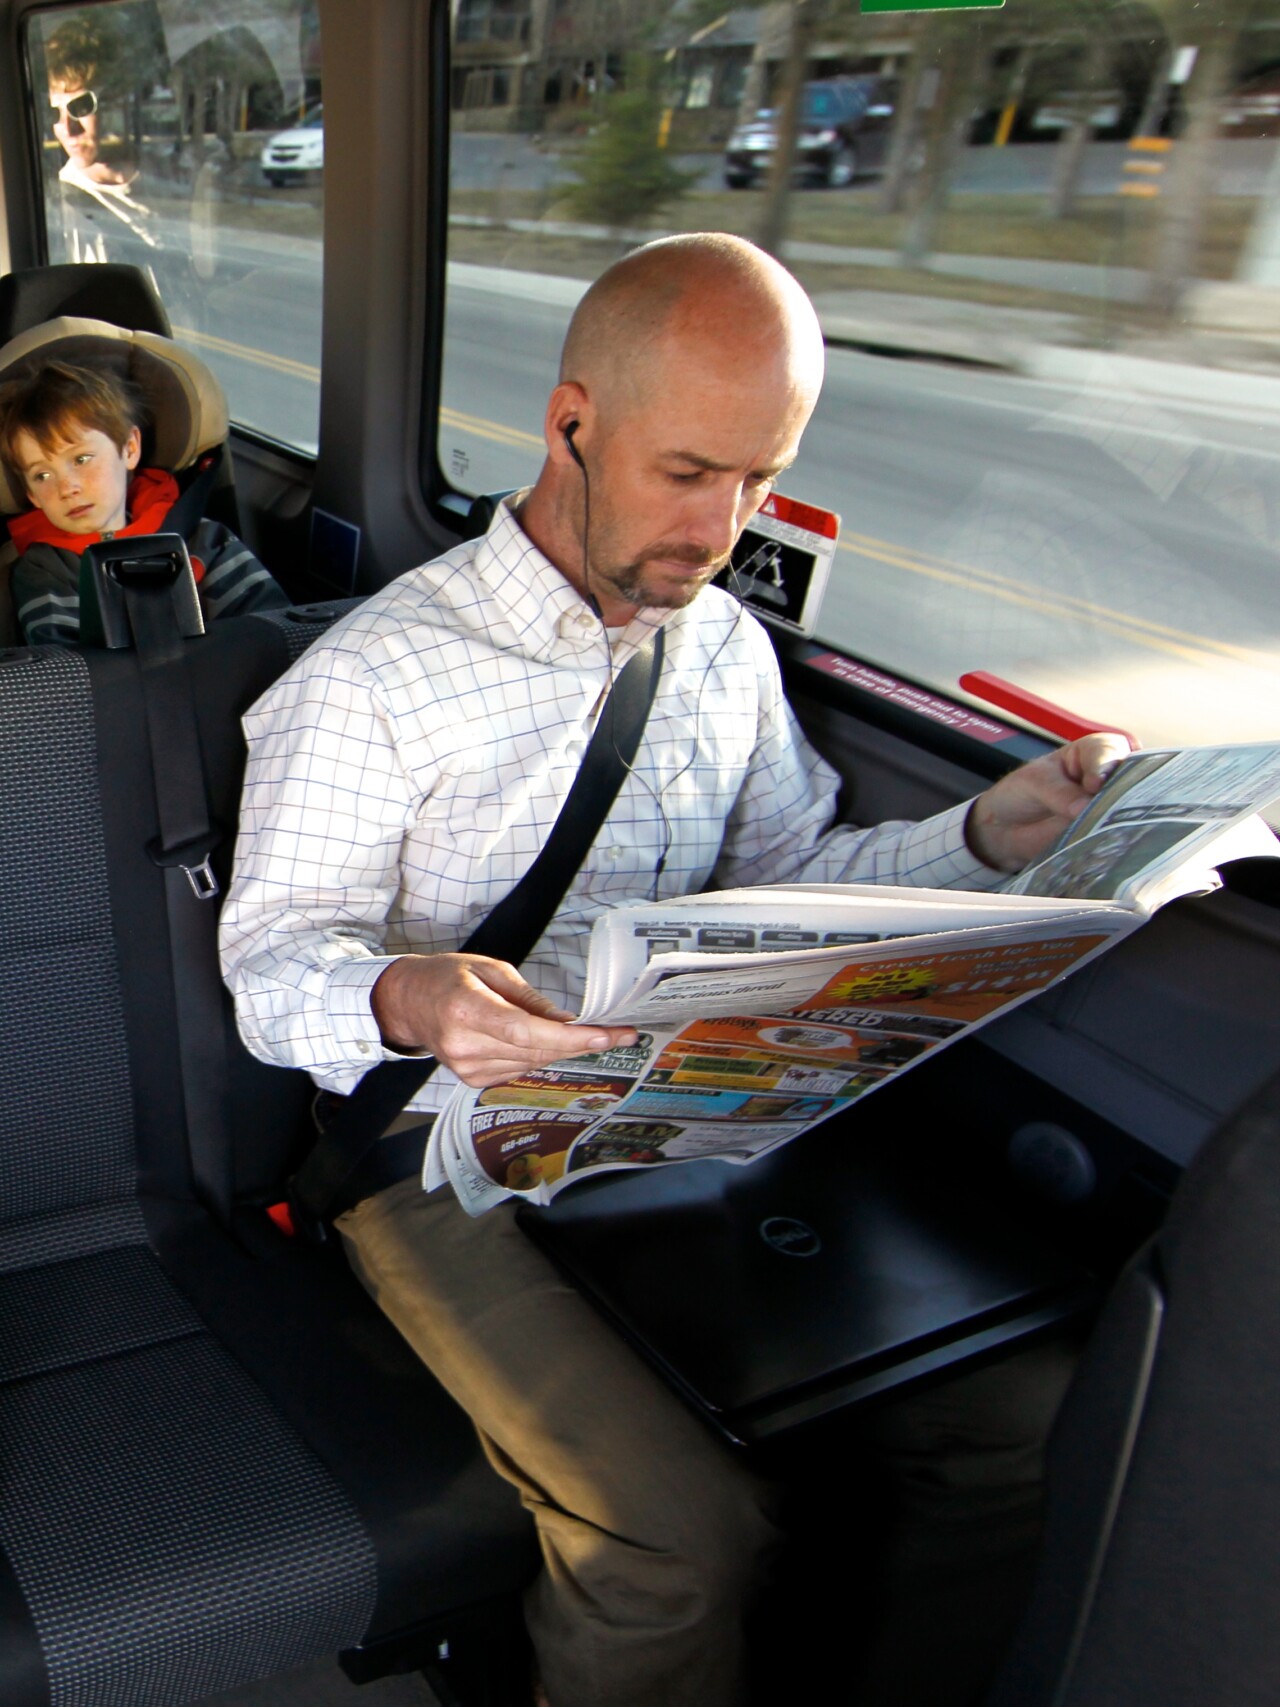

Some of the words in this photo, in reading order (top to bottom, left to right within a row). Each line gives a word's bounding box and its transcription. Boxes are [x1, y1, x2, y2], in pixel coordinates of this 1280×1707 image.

[831, 657, 858, 671] Turn
[896, 687, 931, 703] push
[929, 701, 955, 713] out
[966, 717, 1003, 735] open
[846, 674, 876, 688] case
[889, 693, 960, 725] emergency
[649, 988, 732, 1002] Infectious
[732, 981, 787, 995] threat
[471, 1112, 496, 1135] FREE
[495, 1110, 540, 1126] COOKIE
[538, 1111, 560, 1121] OR
[557, 1113, 599, 1124] CHIPS
[602, 1122, 682, 1139] DAM
